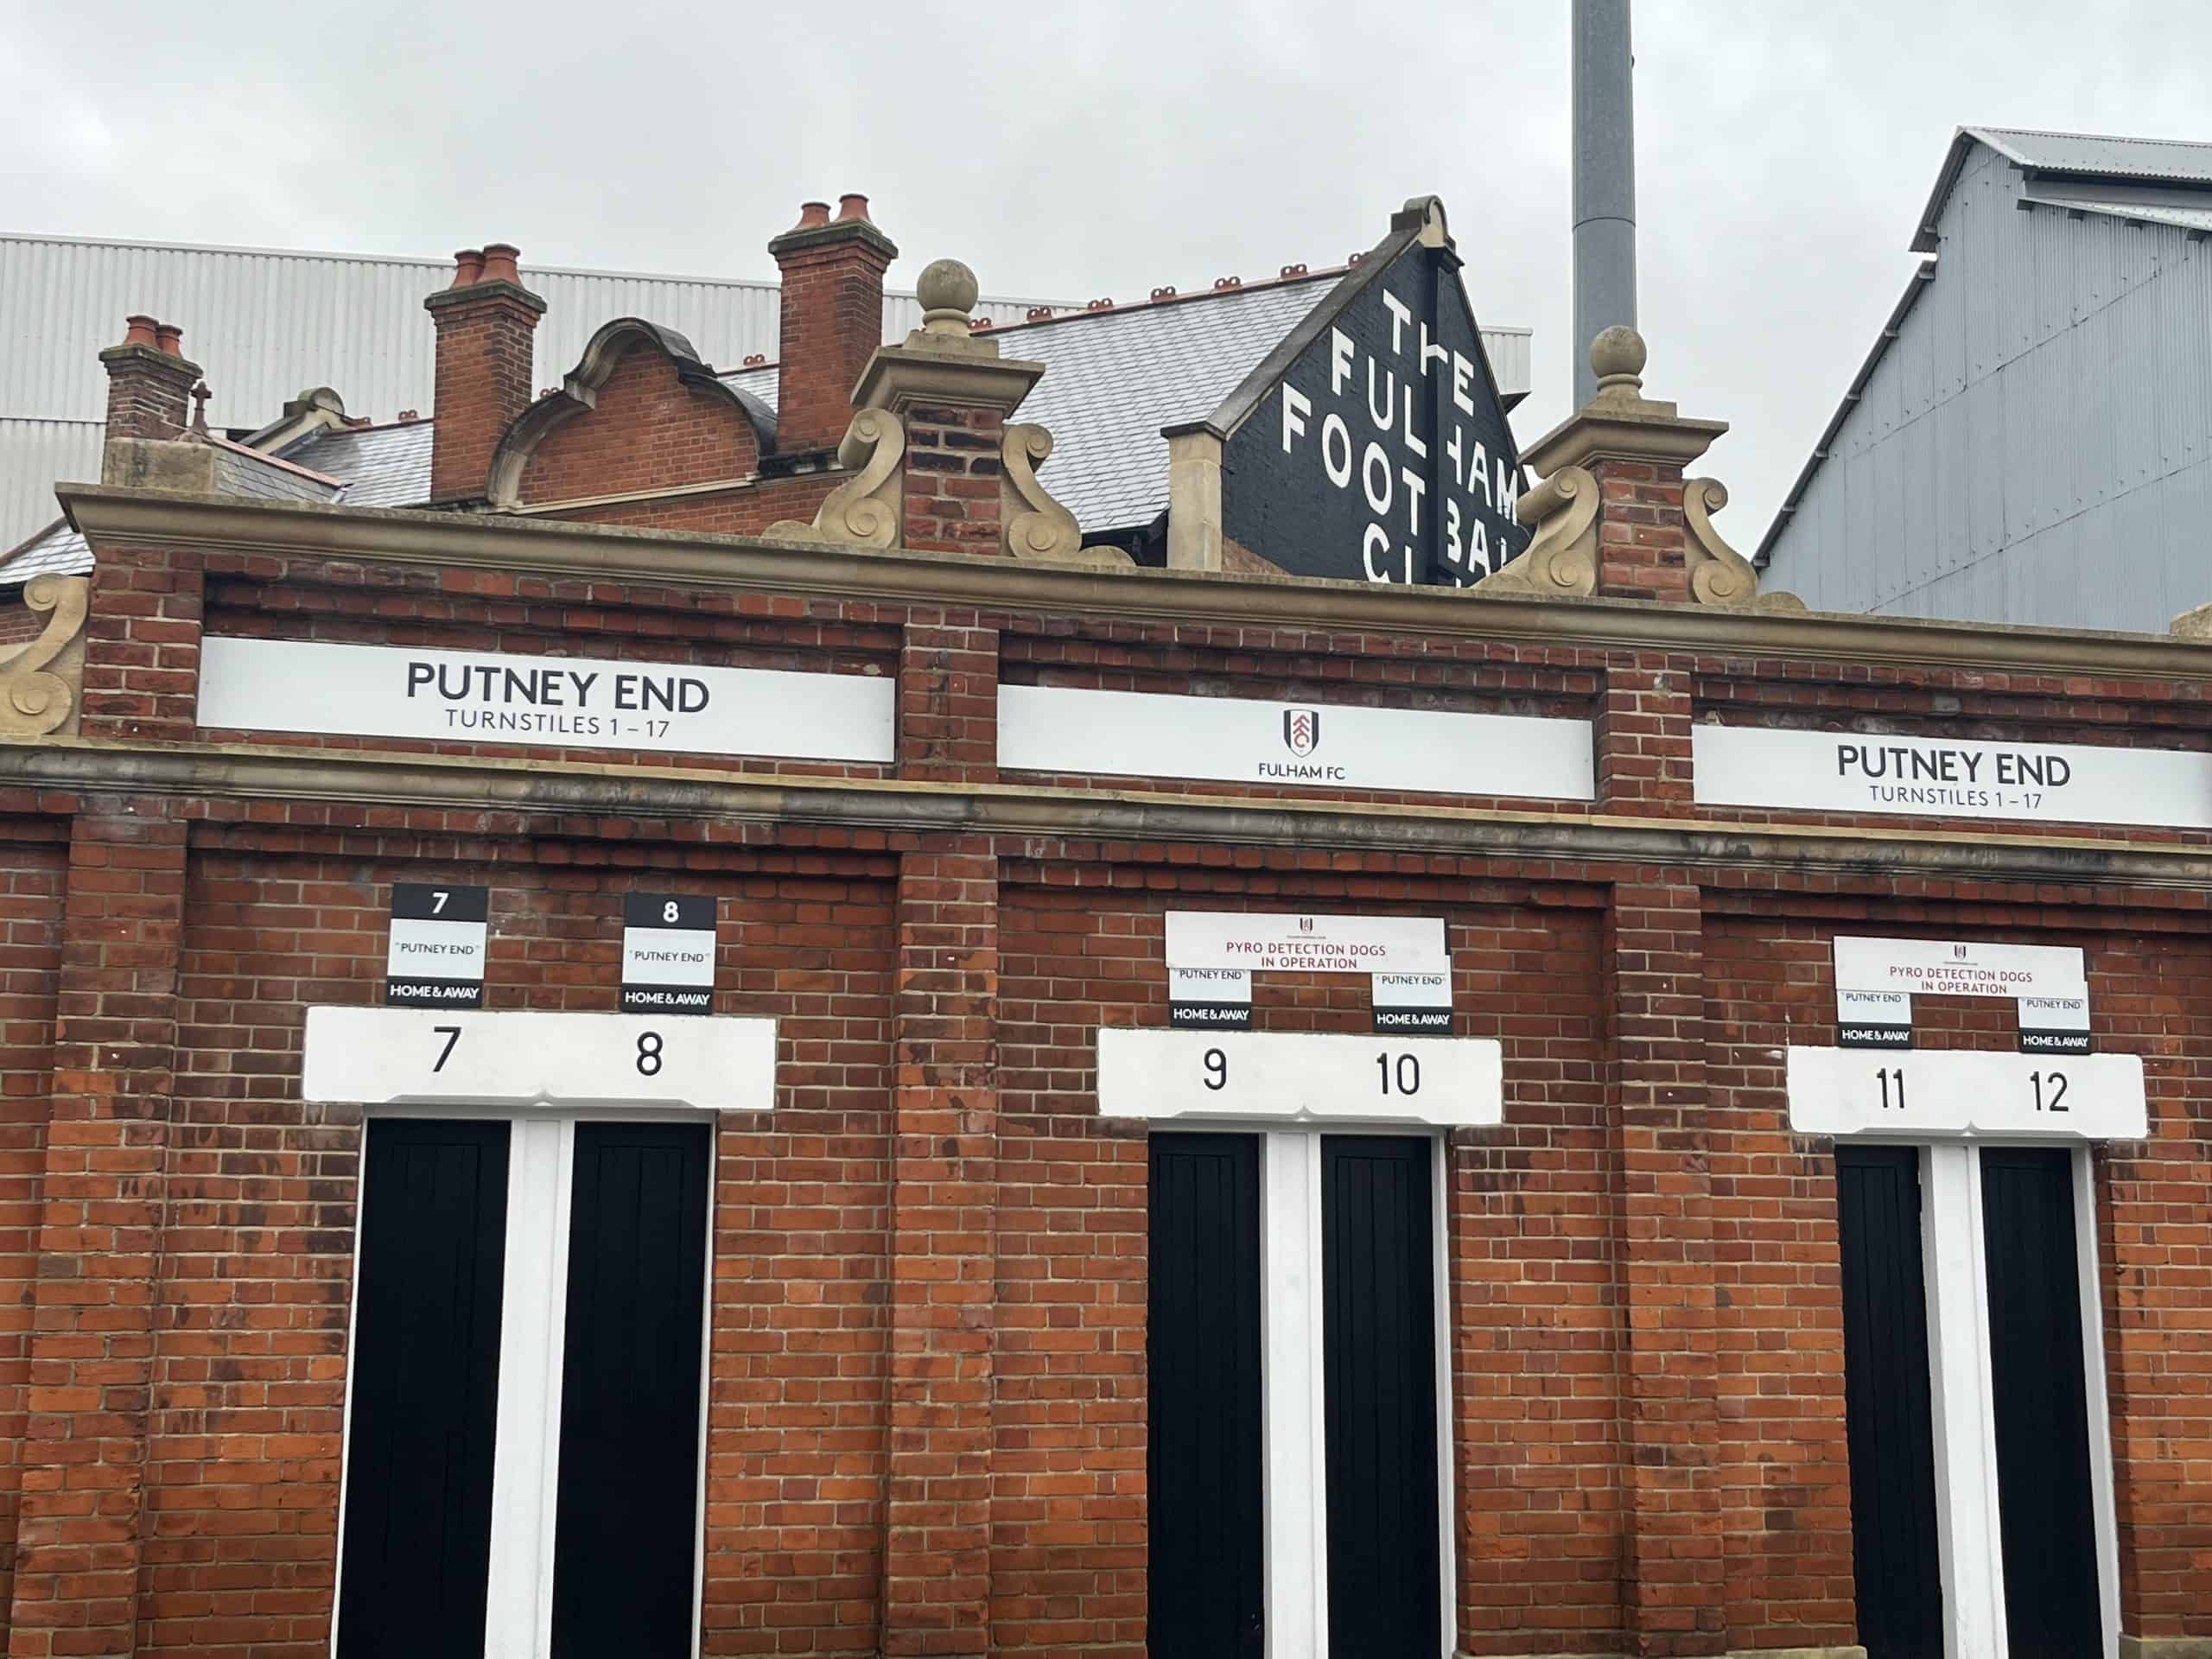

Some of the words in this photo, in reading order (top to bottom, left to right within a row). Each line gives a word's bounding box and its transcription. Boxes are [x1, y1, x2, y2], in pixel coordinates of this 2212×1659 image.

[1383, 289, 1474, 416] THE
[1282, 380, 1508, 575] FOOTBAL
[407, 662, 598, 707] PUTNEY
[614, 674, 709, 714] END
[445, 709, 600, 734] TURNSTILES
[1258, 762, 1322, 779] FULHAM
[1326, 766, 1346, 780] FC
[1838, 744, 1983, 783] PUTNEY
[1996, 753, 2071, 787] END
[1869, 785, 1989, 806] TURNSTILES
[432, 892, 449, 914] 7
[663, 900, 679, 923] 8
[400, 943, 448, 954] PUTNEY
[449, 944, 474, 955] END
[634, 950, 679, 962] PUTNEY
[681, 952, 704, 963] END
[1226, 941, 1263, 954] PYRO
[1268, 943, 1344, 955] DETECTION
[1350, 944, 1386, 957] DOGS
[1261, 957, 1274, 968] IN
[1280, 957, 1357, 969] OPERATION
[1889, 966, 1923, 978] PYRO
[1927, 968, 1995, 981] DETECTION
[1999, 971, 2033, 982] DOGS
[1179, 969, 1219, 979] PUTNEY
[1221, 970, 1243, 980] END
[1382, 975, 1420, 984] PUTNEY
[1421, 976, 1442, 985] END
[1846, 993, 1881, 1002] PUTNEY
[1883, 994, 1902, 1003] END
[1921, 981, 1934, 991] IN
[1938, 981, 2007, 995] OPERATION
[2026, 999, 2061, 1009] PUTNEY
[2063, 1001, 2081, 1009] END
[432, 1026, 462, 1073] 7
[636, 1031, 664, 1077] 8
[1203, 1047, 1228, 1090] 9
[1376, 1052, 1421, 1096] 10
[1876, 1067, 1905, 1109] 11
[2029, 1071, 2070, 1113] 12
